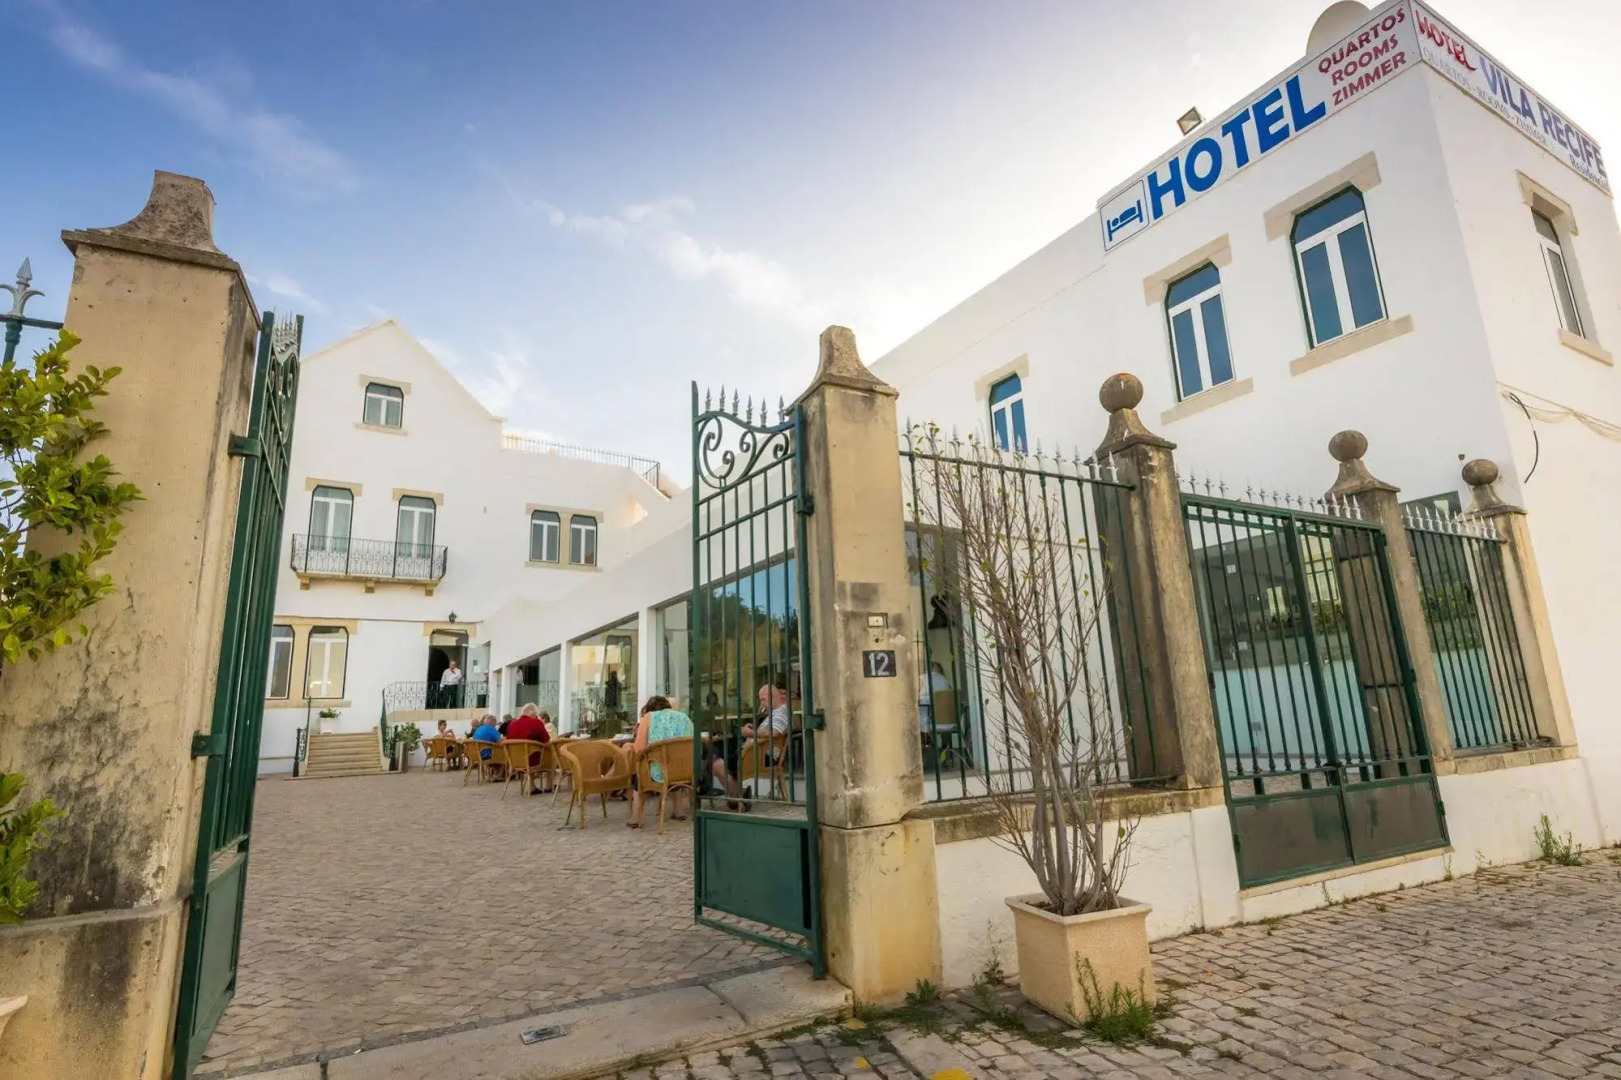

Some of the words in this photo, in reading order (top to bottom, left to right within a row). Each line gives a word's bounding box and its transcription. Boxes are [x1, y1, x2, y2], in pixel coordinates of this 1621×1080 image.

[1318, 8, 1405, 74] QUARTOS
[1331, 33, 1398, 86] ROOMS
[1332, 51, 1406, 106] ZIMMER
[1415, 10, 1477, 71] HOTEL
[1479, 56, 1537, 127] VILA
[1538, 101, 1607, 179] RECIFE
[1147, 75, 1326, 220] HOTEL
[868, 652, 890, 676] 12
